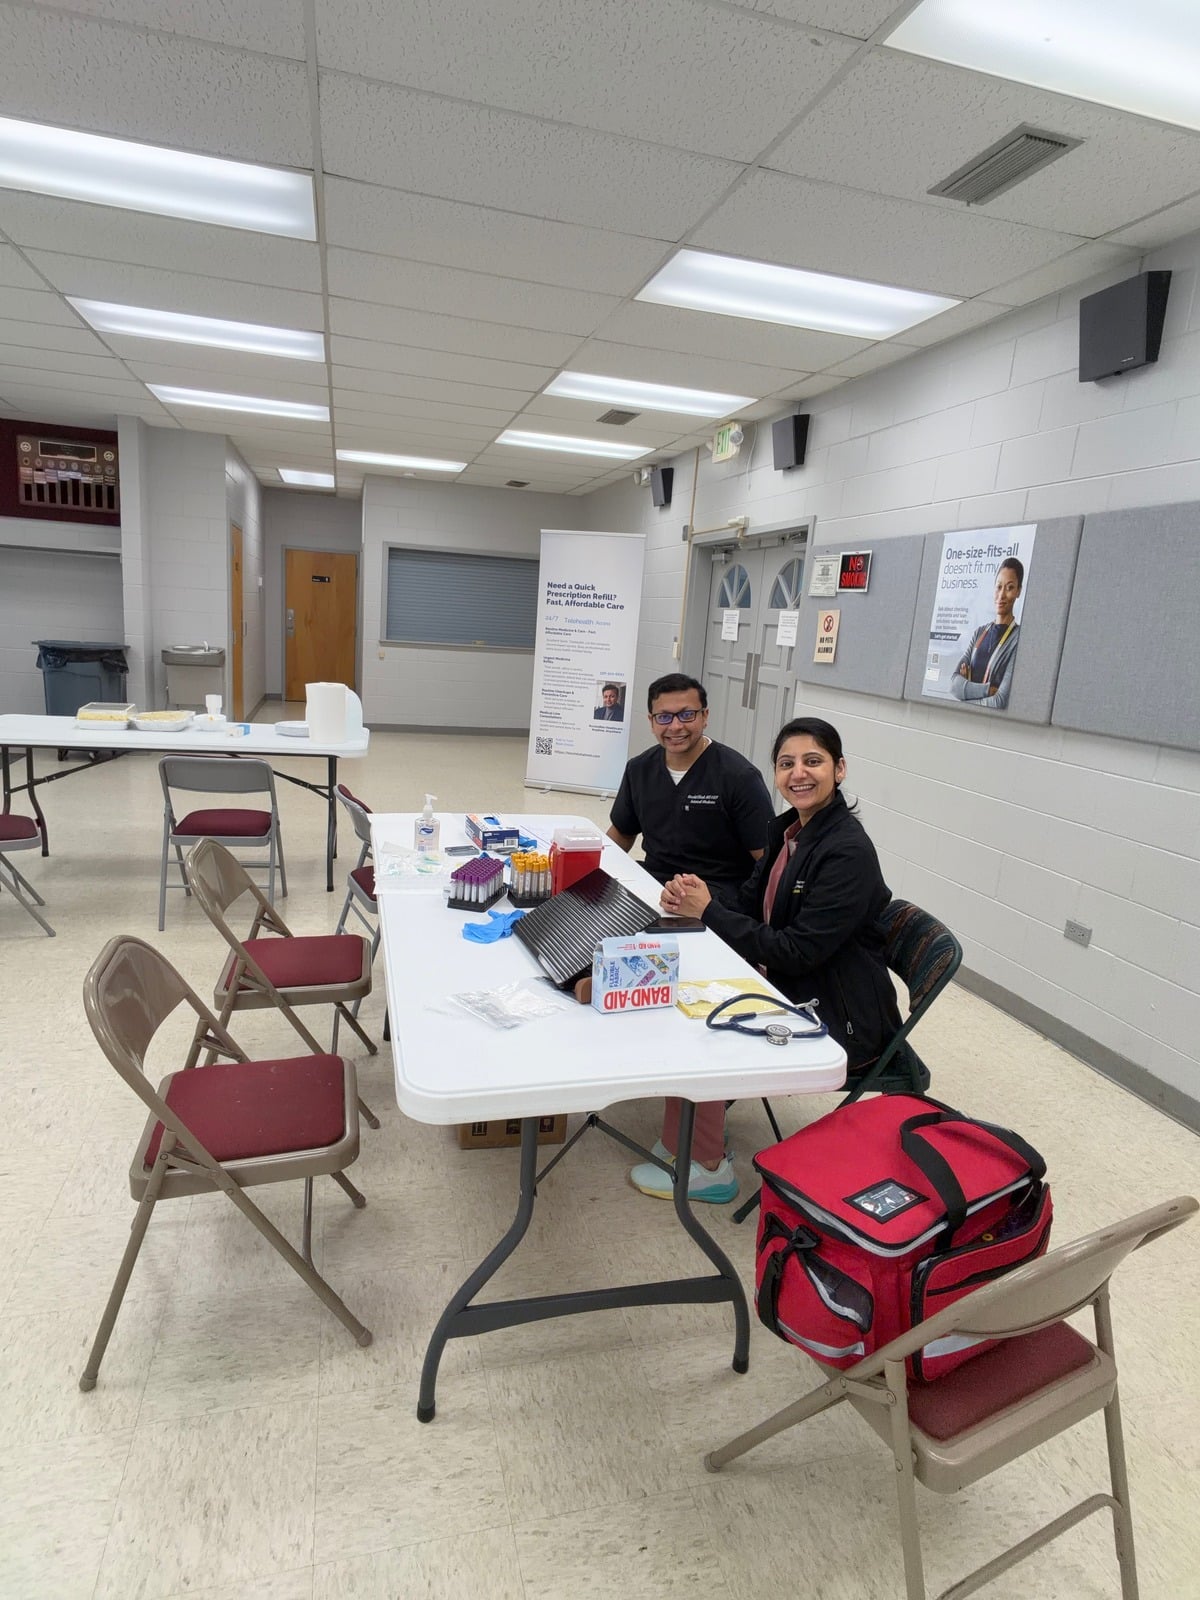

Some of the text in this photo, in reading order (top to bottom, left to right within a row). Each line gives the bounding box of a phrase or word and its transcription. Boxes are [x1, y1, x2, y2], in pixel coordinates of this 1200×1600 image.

[716, 427, 731, 455] EXIT
[945, 543, 1020, 560] One-size-fits-all
[849, 556, 865, 572] NO
[943, 561, 998, 576] doesn't fit my
[547, 582, 567, 590] Need
[574, 583, 596, 591] Quick
[941, 576, 979, 589] business.
[546, 590, 617, 601] Prescription Refill?
[546, 599, 563, 607] Fast,
[564, 600, 605, 609] Affordable
[564, 618, 594, 626] Telehealth
[604, 986, 670, 1010] BAND-AID
